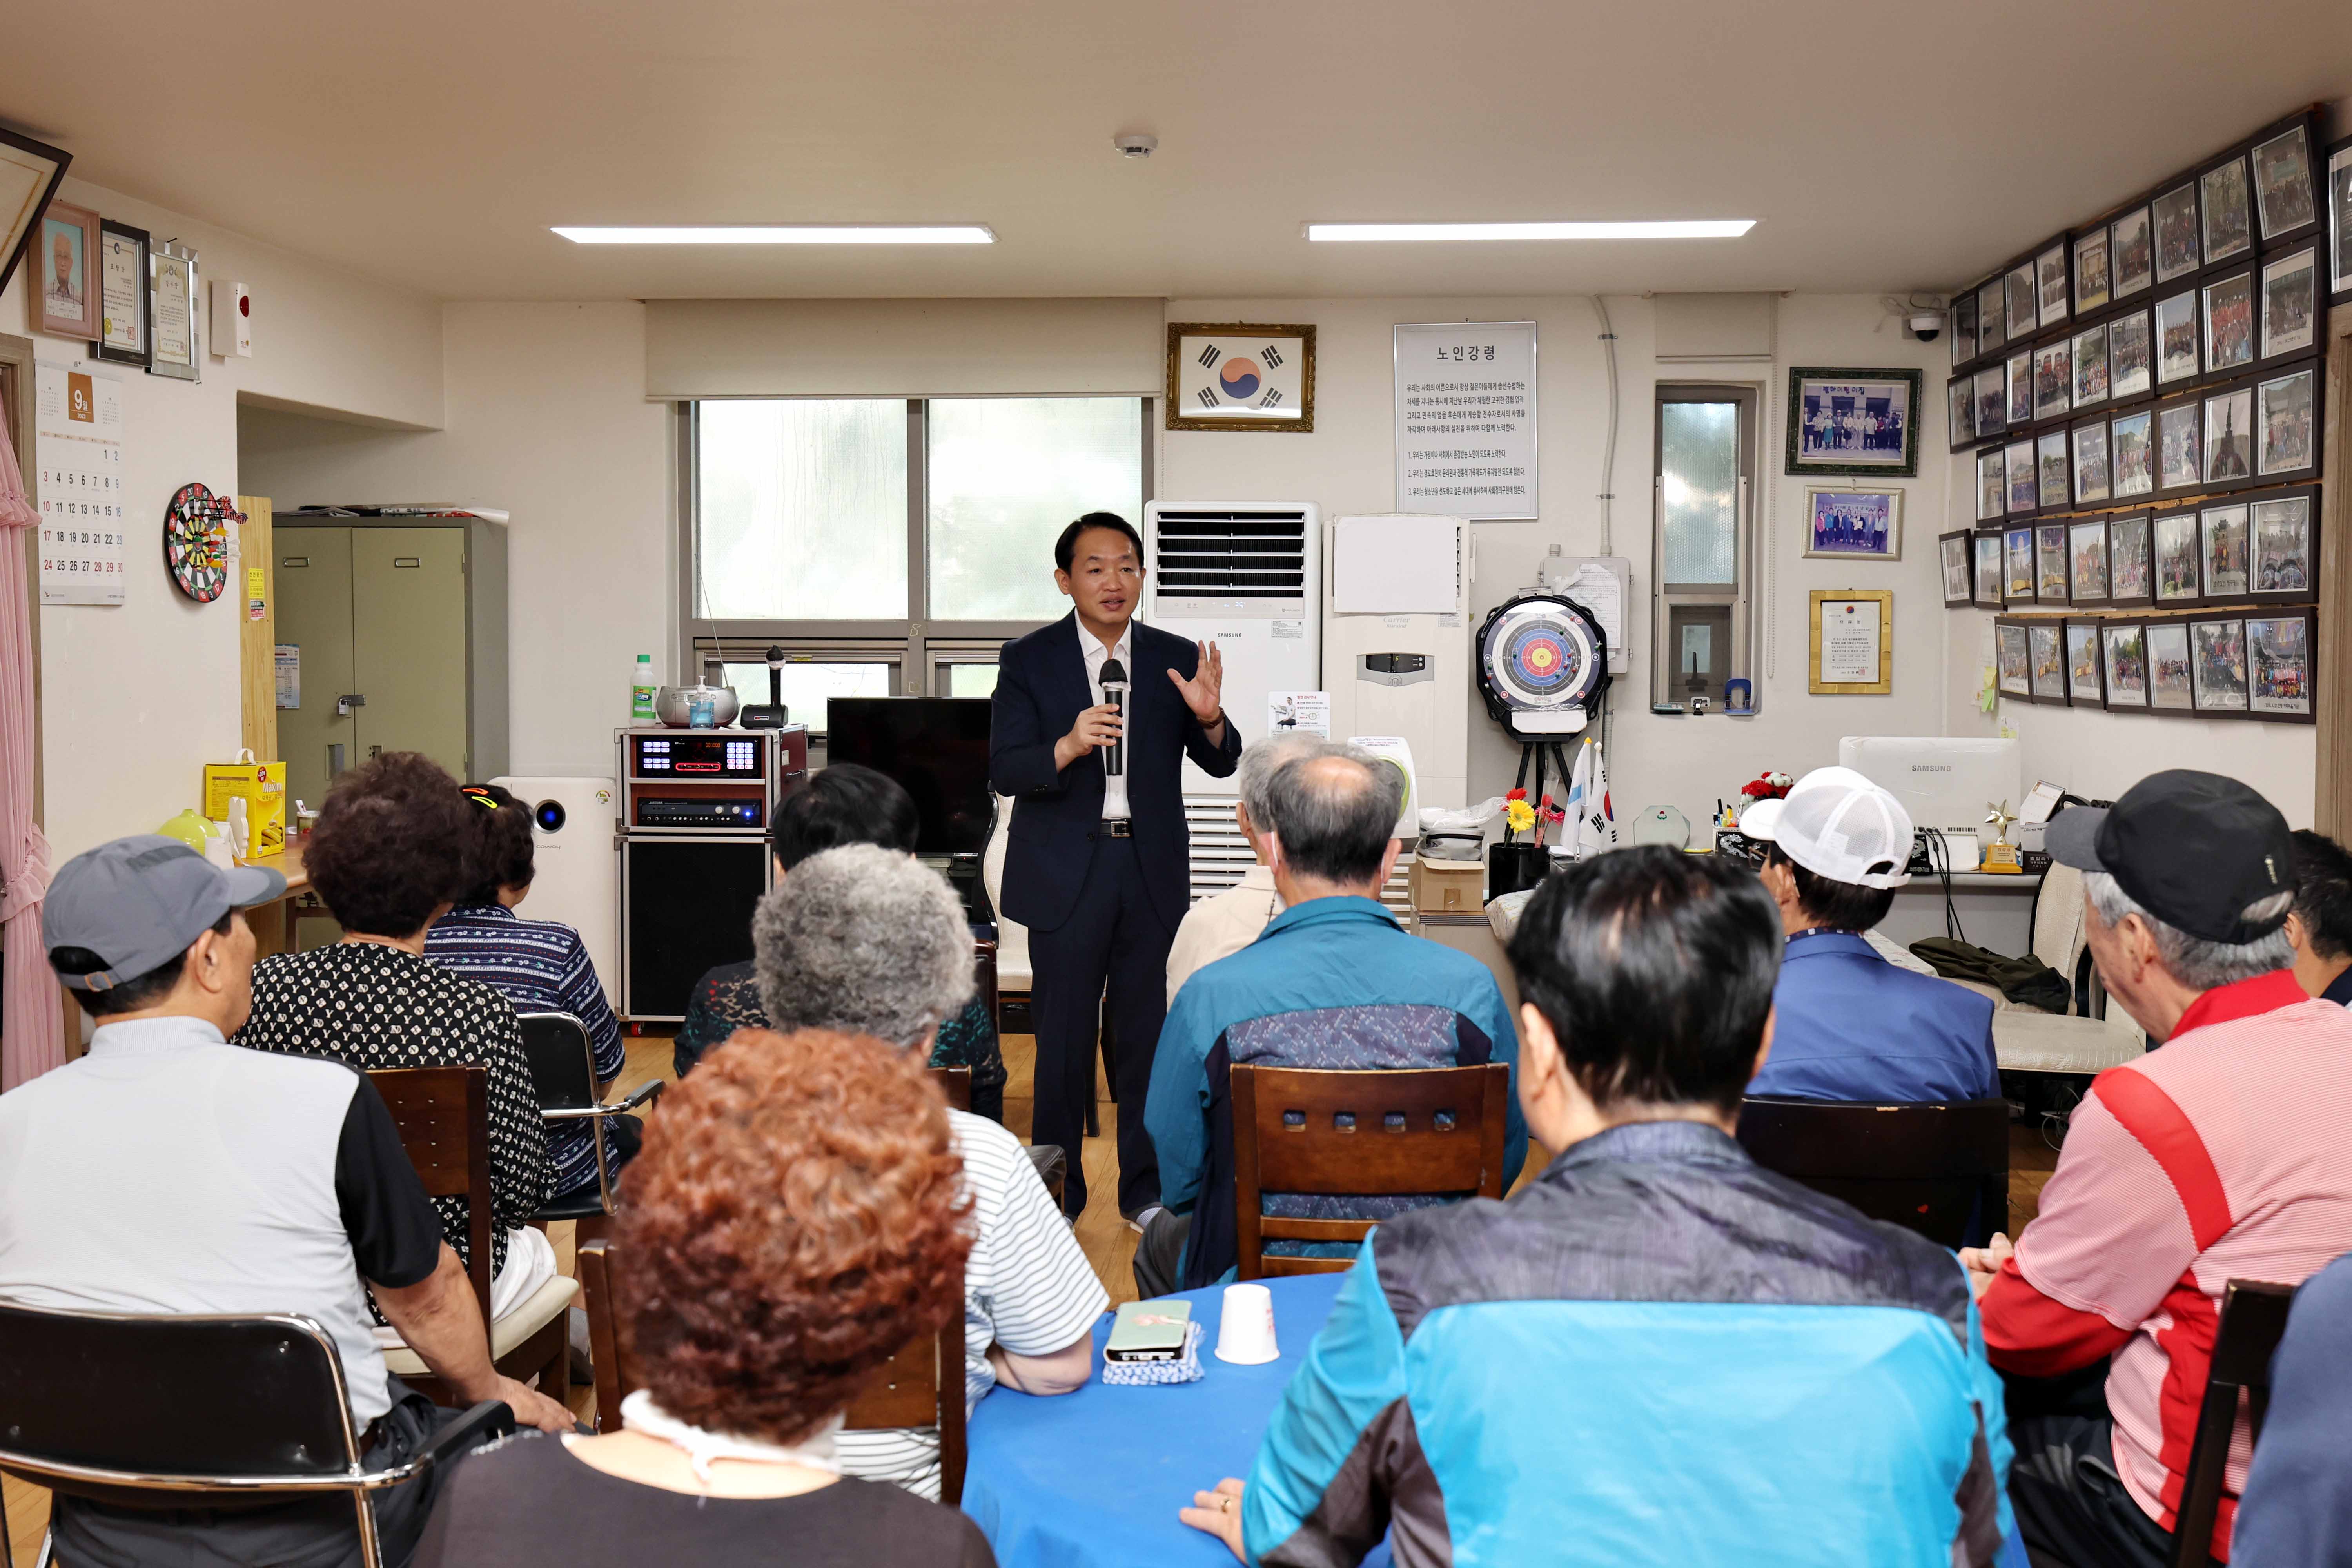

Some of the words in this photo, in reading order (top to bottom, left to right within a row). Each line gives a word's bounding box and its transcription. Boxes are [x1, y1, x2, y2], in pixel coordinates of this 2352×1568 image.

[1437, 345, 1494, 361] 노인강령
[1407, 384, 1420, 392] 우리는
[1460, 383, 1468, 391] 항상
[1470, 382, 1497, 391] 젊은이들에게
[1498, 382, 1525, 390] 솔선수범하는
[1407, 397, 1420, 406] 자세를
[1421, 397, 1434, 406] 지니는
[1435, 397, 1448, 405] 동시에
[1449, 397, 1462, 405] 지난날
[1463, 396, 1476, 405] 우리가
[1477, 396, 1490, 405] 체험한
[1492, 396, 1504, 404] 고귀한
[1505, 396, 1514, 404] 경험
[1515, 396, 1524, 404] 업적
[1422, 411, 1436, 419] 민족의
[1437, 411, 1446, 419] 얼을
[1448, 411, 1466, 419] 후손에게
[1468, 410, 1481, 419] 계승할
[1483, 410, 1510, 418] 전수자로서의
[1512, 409, 1525, 417] 사명을
[1427, 425, 1449, 433] 아래사항의
[1451, 425, 1465, 433] 실천을
[1481, 424, 1495, 432] 다함께
[104, 449, 107, 459] 1
[114, 451, 118, 461] 2
[44, 471, 47, 482] 3
[57, 472, 60, 483] 4
[69, 474, 73, 484] 5
[82, 475, 85, 485] 6
[94, 477, 97, 486] 7
[105, 477, 109, 488] 8
[116, 479, 119, 489] 9
[43, 501, 50, 512] 10
[56, 502, 62, 512] 11
[69, 503, 75, 513] 12
[81, 504, 87, 514] 13
[93, 505, 99, 515] 14
[105, 506, 111, 516] 15
[116, 507, 121, 517] 16
[174, 503, 179, 512] 12
[44, 530, 51, 541] 17
[57, 532, 64, 541] 18
[69, 532, 76, 543] 19
[82, 533, 88, 543] 20
[94, 534, 100, 543] 21
[105, 534, 113, 544] 22
[117, 535, 122, 545] 23
[44, 560, 52, 570] 24
[57, 560, 65, 570] 25
[70, 561, 77, 571] 26
[82, 561, 89, 571] 27
[94, 562, 102, 572] 28
[106, 562, 113, 572] 29
[118, 563, 122, 572] 30
[263, 782, 282, 793] Maxim
